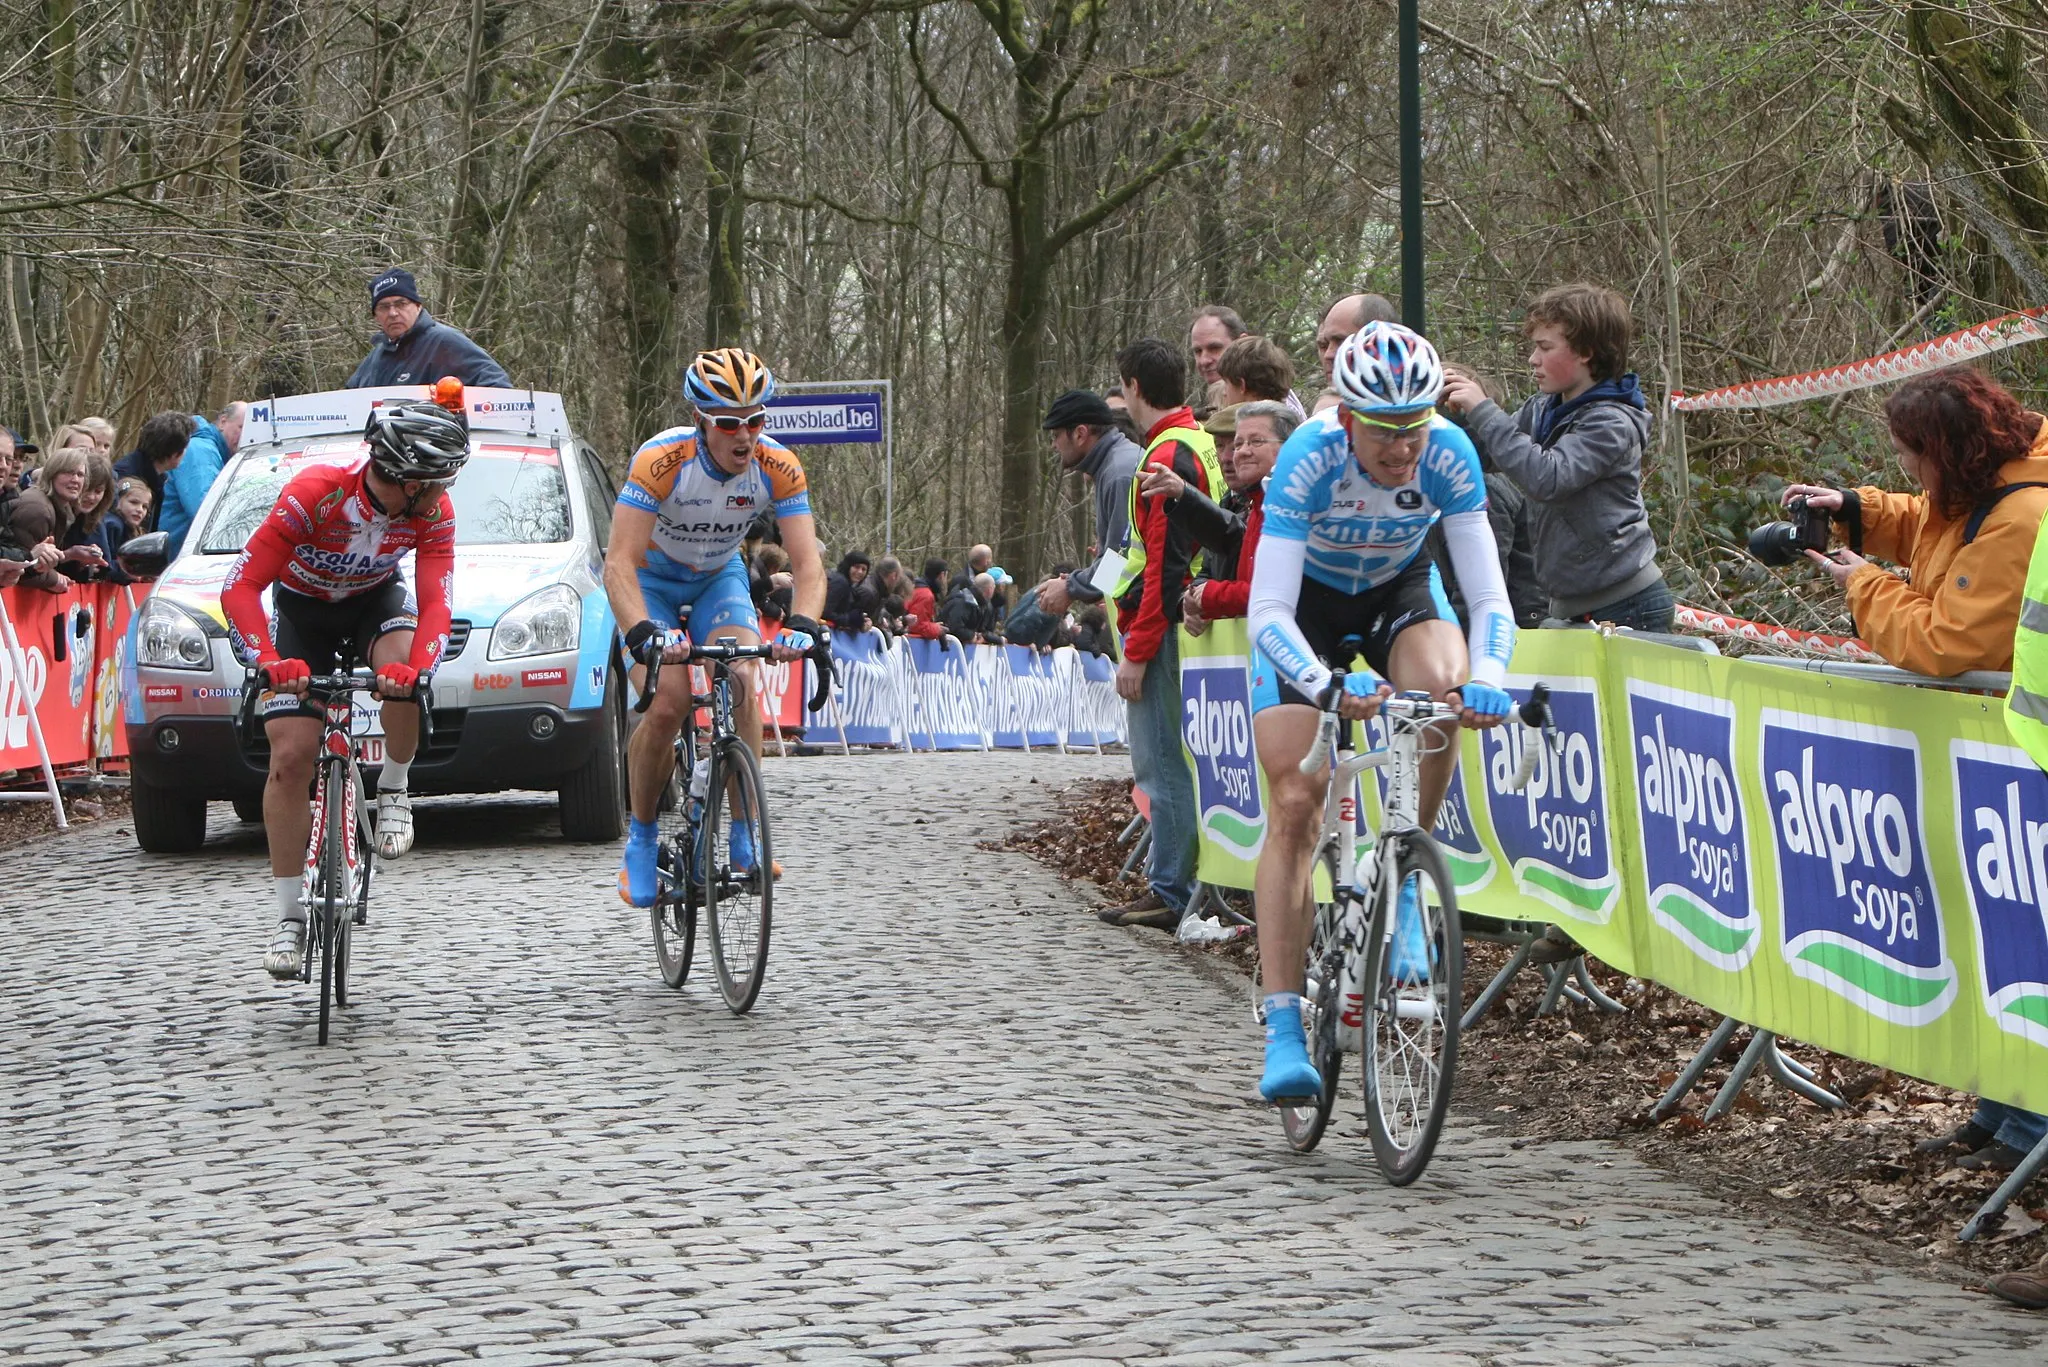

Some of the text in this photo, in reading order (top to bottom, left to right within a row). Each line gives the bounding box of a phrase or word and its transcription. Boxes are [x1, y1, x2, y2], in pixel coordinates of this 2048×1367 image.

[481, 402, 530, 414] ORDINA
[764, 408, 873, 430] euwsblad.be
[621, 485, 659, 508] GARM
[148, 687, 178, 697] NISSAN
[199, 686, 242, 700] ORDINA
[527, 673, 562, 681] NISSAN
[1186, 678, 1249, 782] alpro
[1220, 765, 1252, 808] soya
[1641, 713, 1734, 854] alpro
[307, 770, 328, 862] OTTECCHIA
[1541, 811, 1592, 864] soya
[1775, 746, 1912, 898] alpro
[1689, 837, 1734, 898] soya
[1851, 879, 1919, 945] soya
